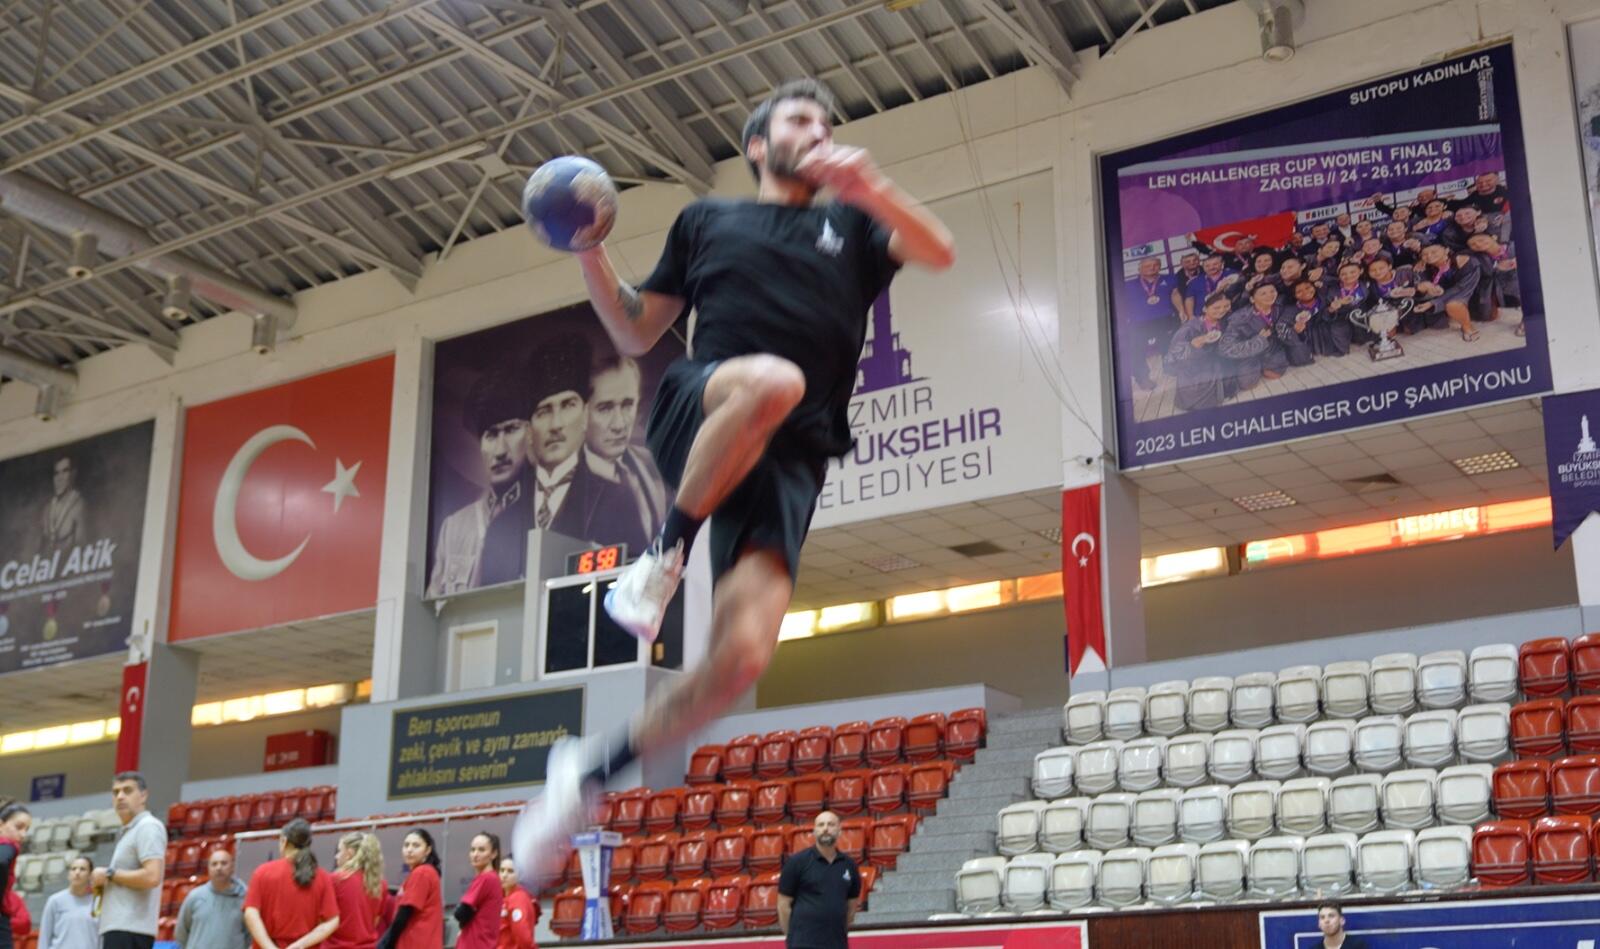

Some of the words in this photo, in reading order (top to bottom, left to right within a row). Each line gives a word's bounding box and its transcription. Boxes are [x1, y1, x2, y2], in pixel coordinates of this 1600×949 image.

[1350, 77, 1409, 106] SUTOPU
[1413, 55, 1491, 87] KADINLAR
[1149, 174, 1177, 189] LEN
[1180, 162, 1281, 186] CHALLENGER
[1285, 157, 1317, 174] CUP
[1320, 149, 1382, 169] WOMEN
[1390, 143, 1438, 161] FINAL
[1442, 140, 1452, 155] 6
[1259, 173, 1324, 192] ZAGREB
[1340, 169, 1358, 183] 24
[1371, 158, 1452, 179] 26.11.2023
[849, 386, 934, 428] ZMİR
[1136, 433, 1176, 457] 2023
[1180, 425, 1216, 447] LEN
[1220, 400, 1351, 439] CHALLENGER
[1356, 390, 1399, 414] CUP
[1404, 365, 1531, 408] ŞAMPİYONU
[819, 446, 992, 509] ELEDİYESİ
[0, 549, 61, 590] Celal
[61, 538, 118, 577] Atik
[408, 717, 432, 736] Ben
[435, 710, 500, 737] sporcunun
[429, 737, 461, 764] çevik
[466, 739, 481, 755] ve
